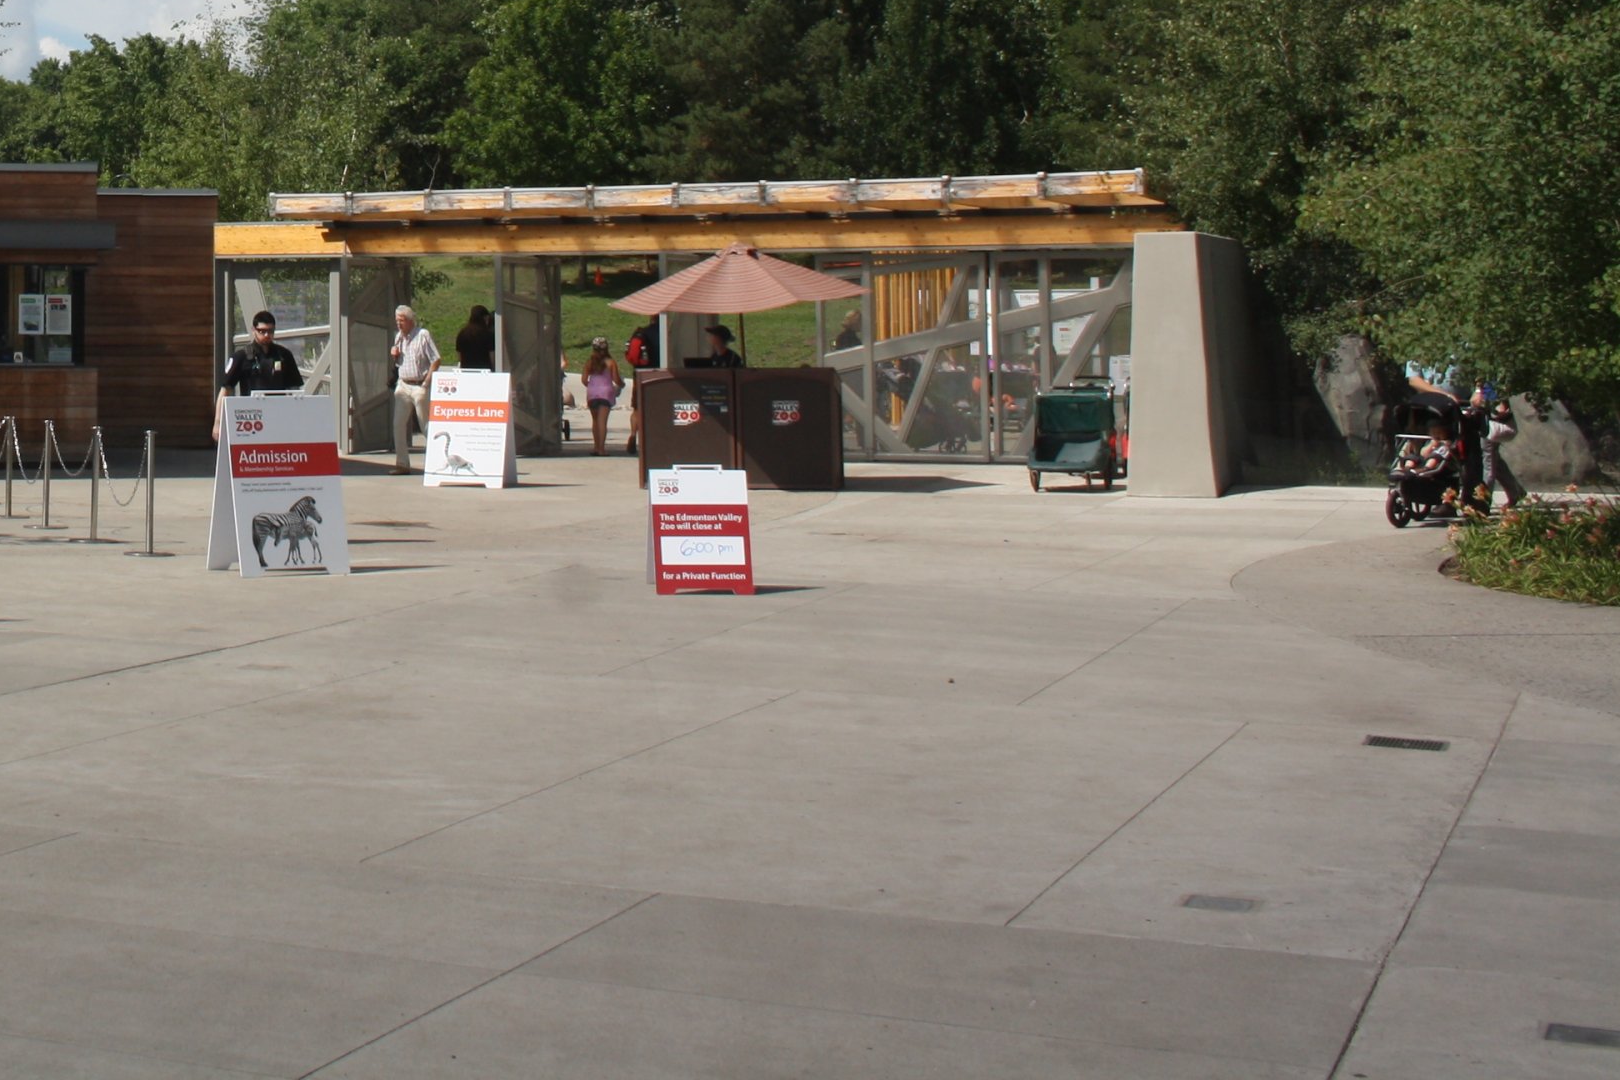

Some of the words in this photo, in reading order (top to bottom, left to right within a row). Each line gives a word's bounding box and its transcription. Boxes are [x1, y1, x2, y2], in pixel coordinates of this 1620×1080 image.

[433, 406, 475, 419] Express
[477, 407, 505, 417] Lane
[674, 411, 700, 421] ZOO
[774, 411, 800, 421] ZOO
[235, 421, 263, 432] ZOO
[239, 449, 308, 463] Admission
[660, 513, 675, 521] The
[676, 513, 717, 521] Edmonton
[718, 513, 743, 523] Valley
[660, 522, 675, 530] Zoo
[676, 522, 691, 530] will
[692, 522, 712, 530] close
[680, 539, 714, 556] 6:00
[718, 544, 733, 556] pm
[663, 572, 674, 580] for
[682, 572, 710, 580] Private
[711, 572, 746, 580] Function
